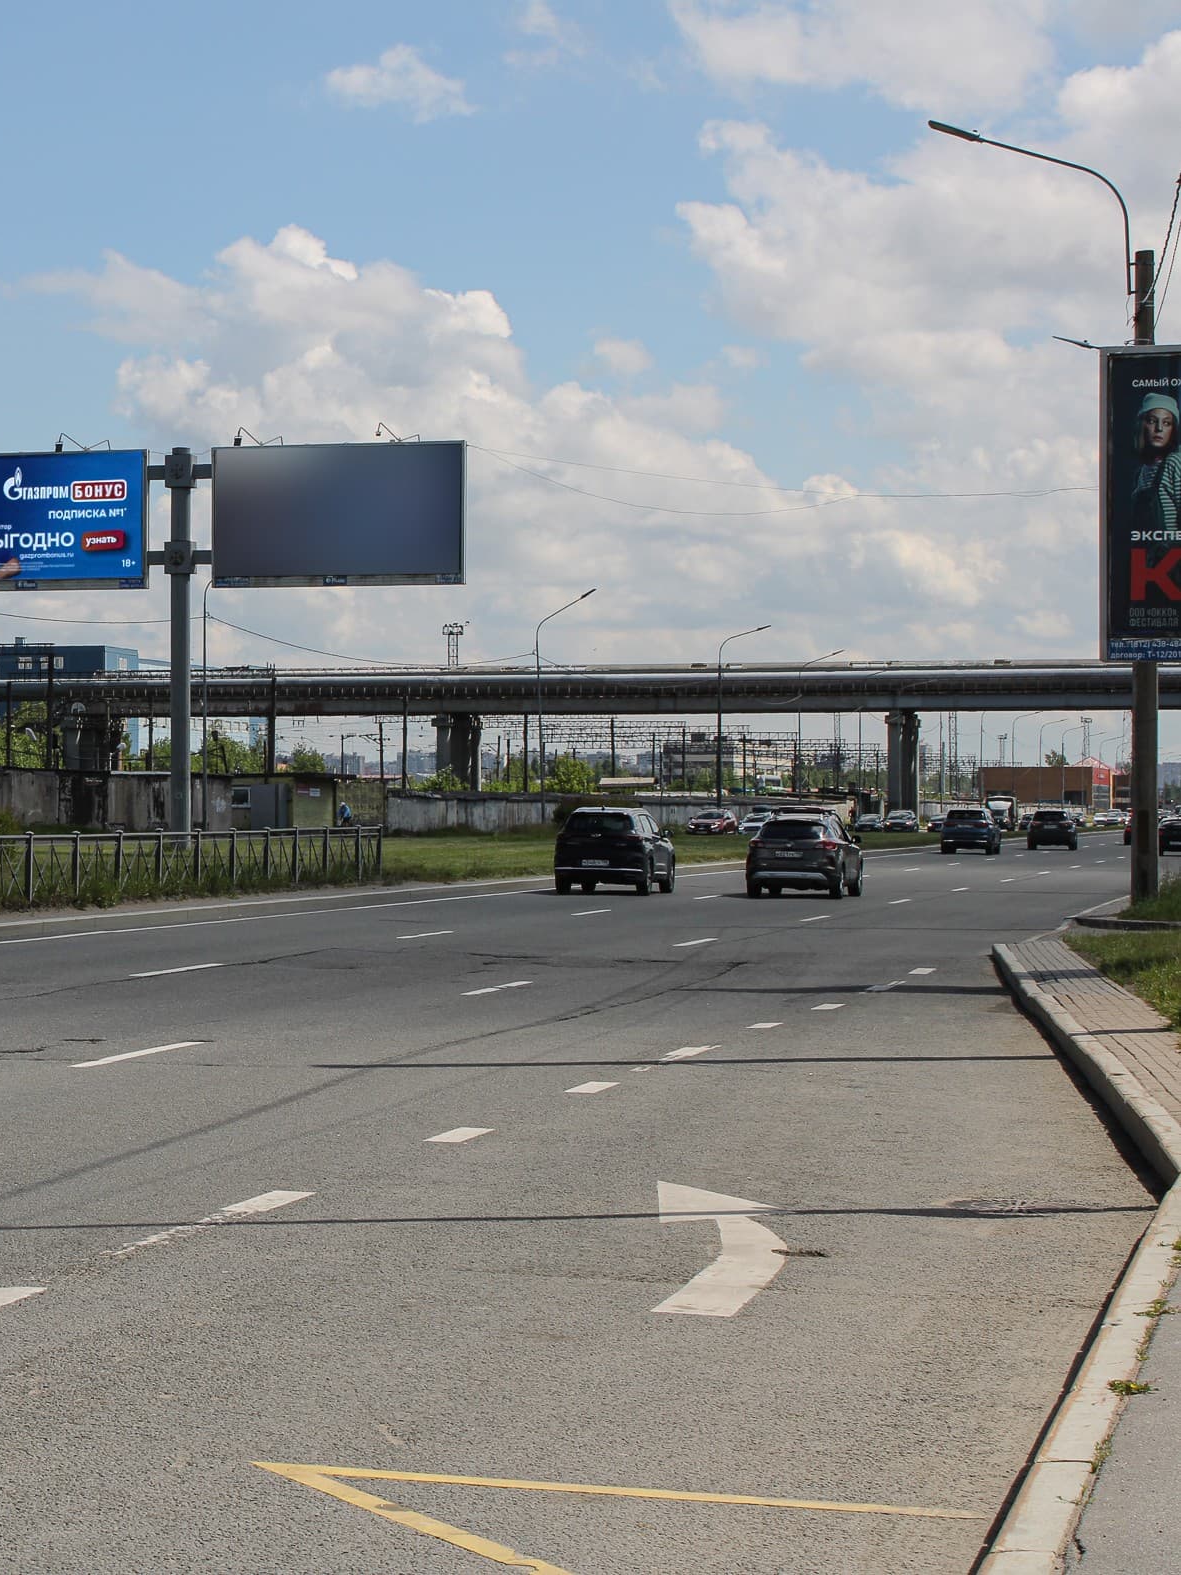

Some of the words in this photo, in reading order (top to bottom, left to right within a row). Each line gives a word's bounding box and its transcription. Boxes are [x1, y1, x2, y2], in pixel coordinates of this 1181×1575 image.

[1131, 377, 1169, 387] САМЫЙ
[74, 484, 123, 498] БОНУС
[48, 509, 107, 520] ПОДПИСКА
[85, 536, 118, 548] узнать
[19, 552, 75, 561] gazprombonus.ru
[121, 558, 136, 568] 18+
